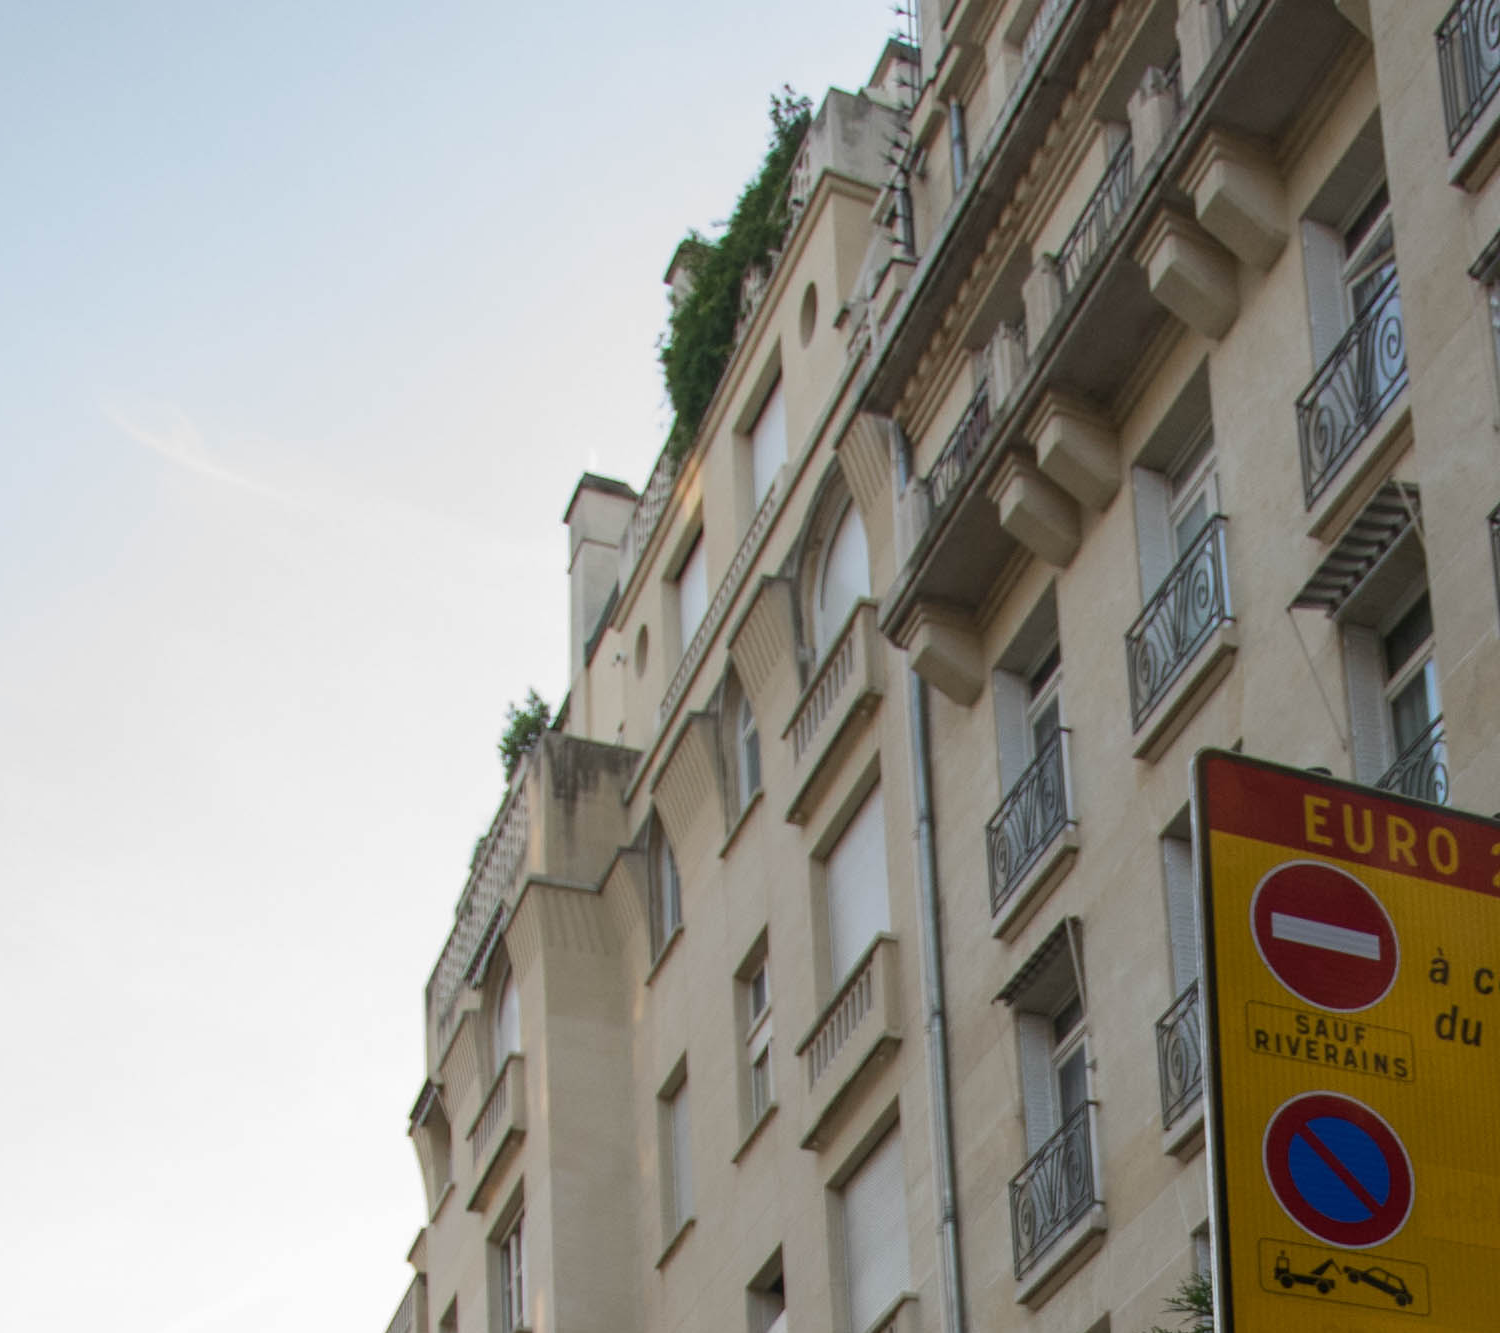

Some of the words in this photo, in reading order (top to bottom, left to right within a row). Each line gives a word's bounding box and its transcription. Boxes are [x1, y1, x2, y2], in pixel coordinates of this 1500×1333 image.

[1303, 794, 1460, 877] EURO
[1428, 947, 1451, 986] à
[1295, 1013, 1368, 1046] SAUF
[1435, 1005, 1482, 1047] du
[1254, 1028, 1409, 1079] RIVERAINS
